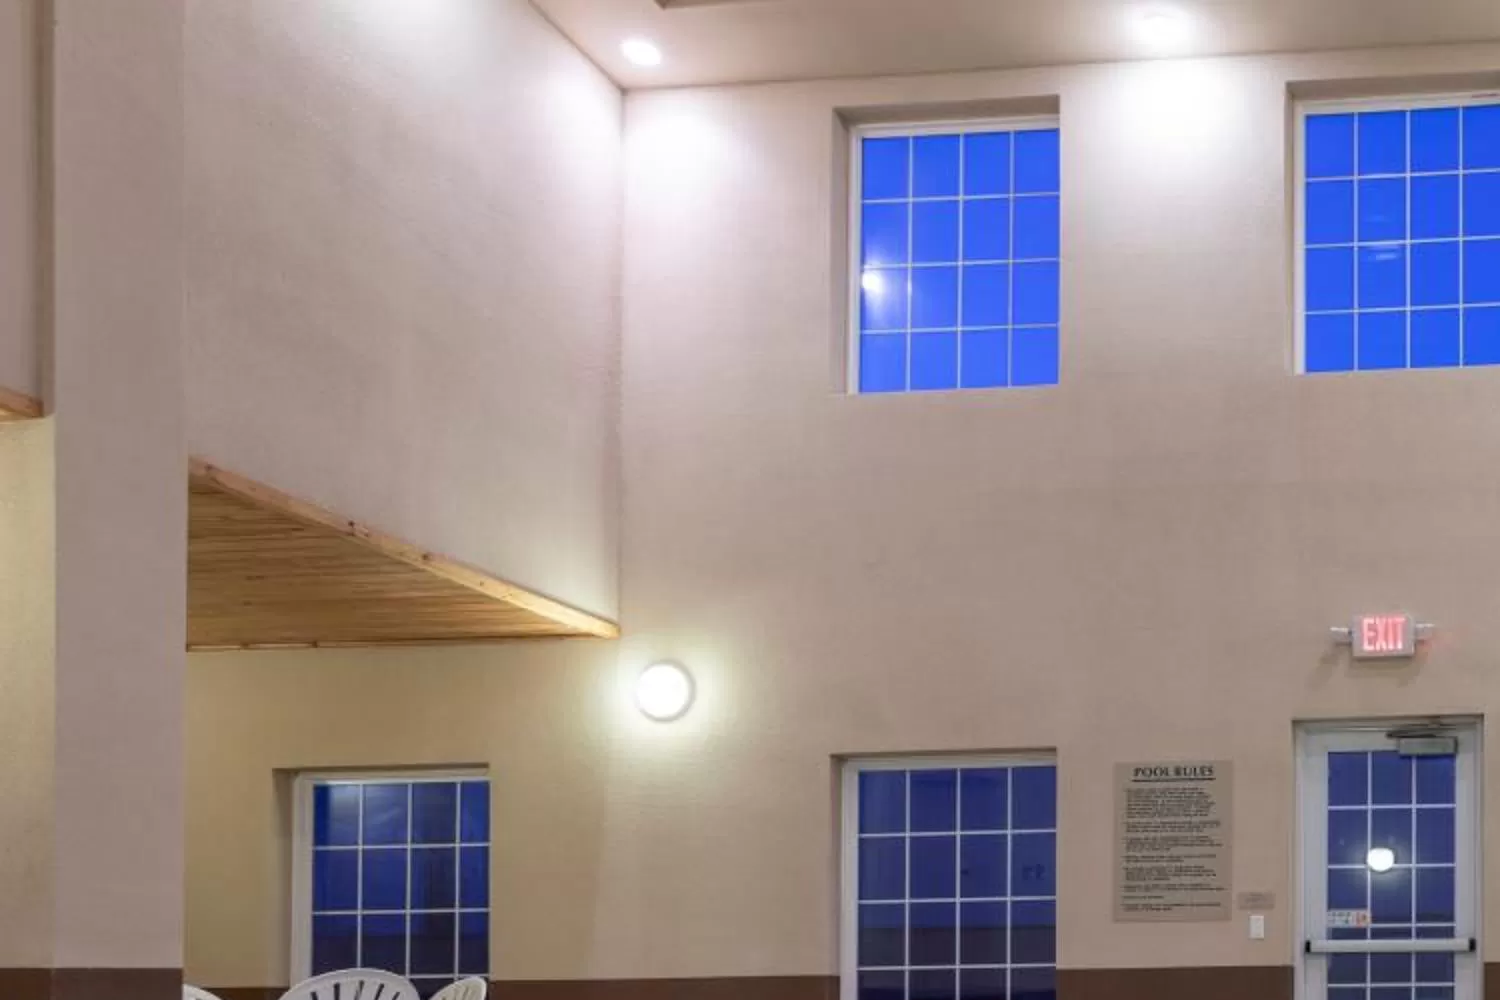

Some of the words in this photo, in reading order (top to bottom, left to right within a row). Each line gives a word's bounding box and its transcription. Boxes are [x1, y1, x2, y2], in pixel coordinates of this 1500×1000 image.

[1363, 616, 1405, 651] EXIT
[1133, 765, 1170, 777] POOL
[1173, 765, 1214, 777] RULES
